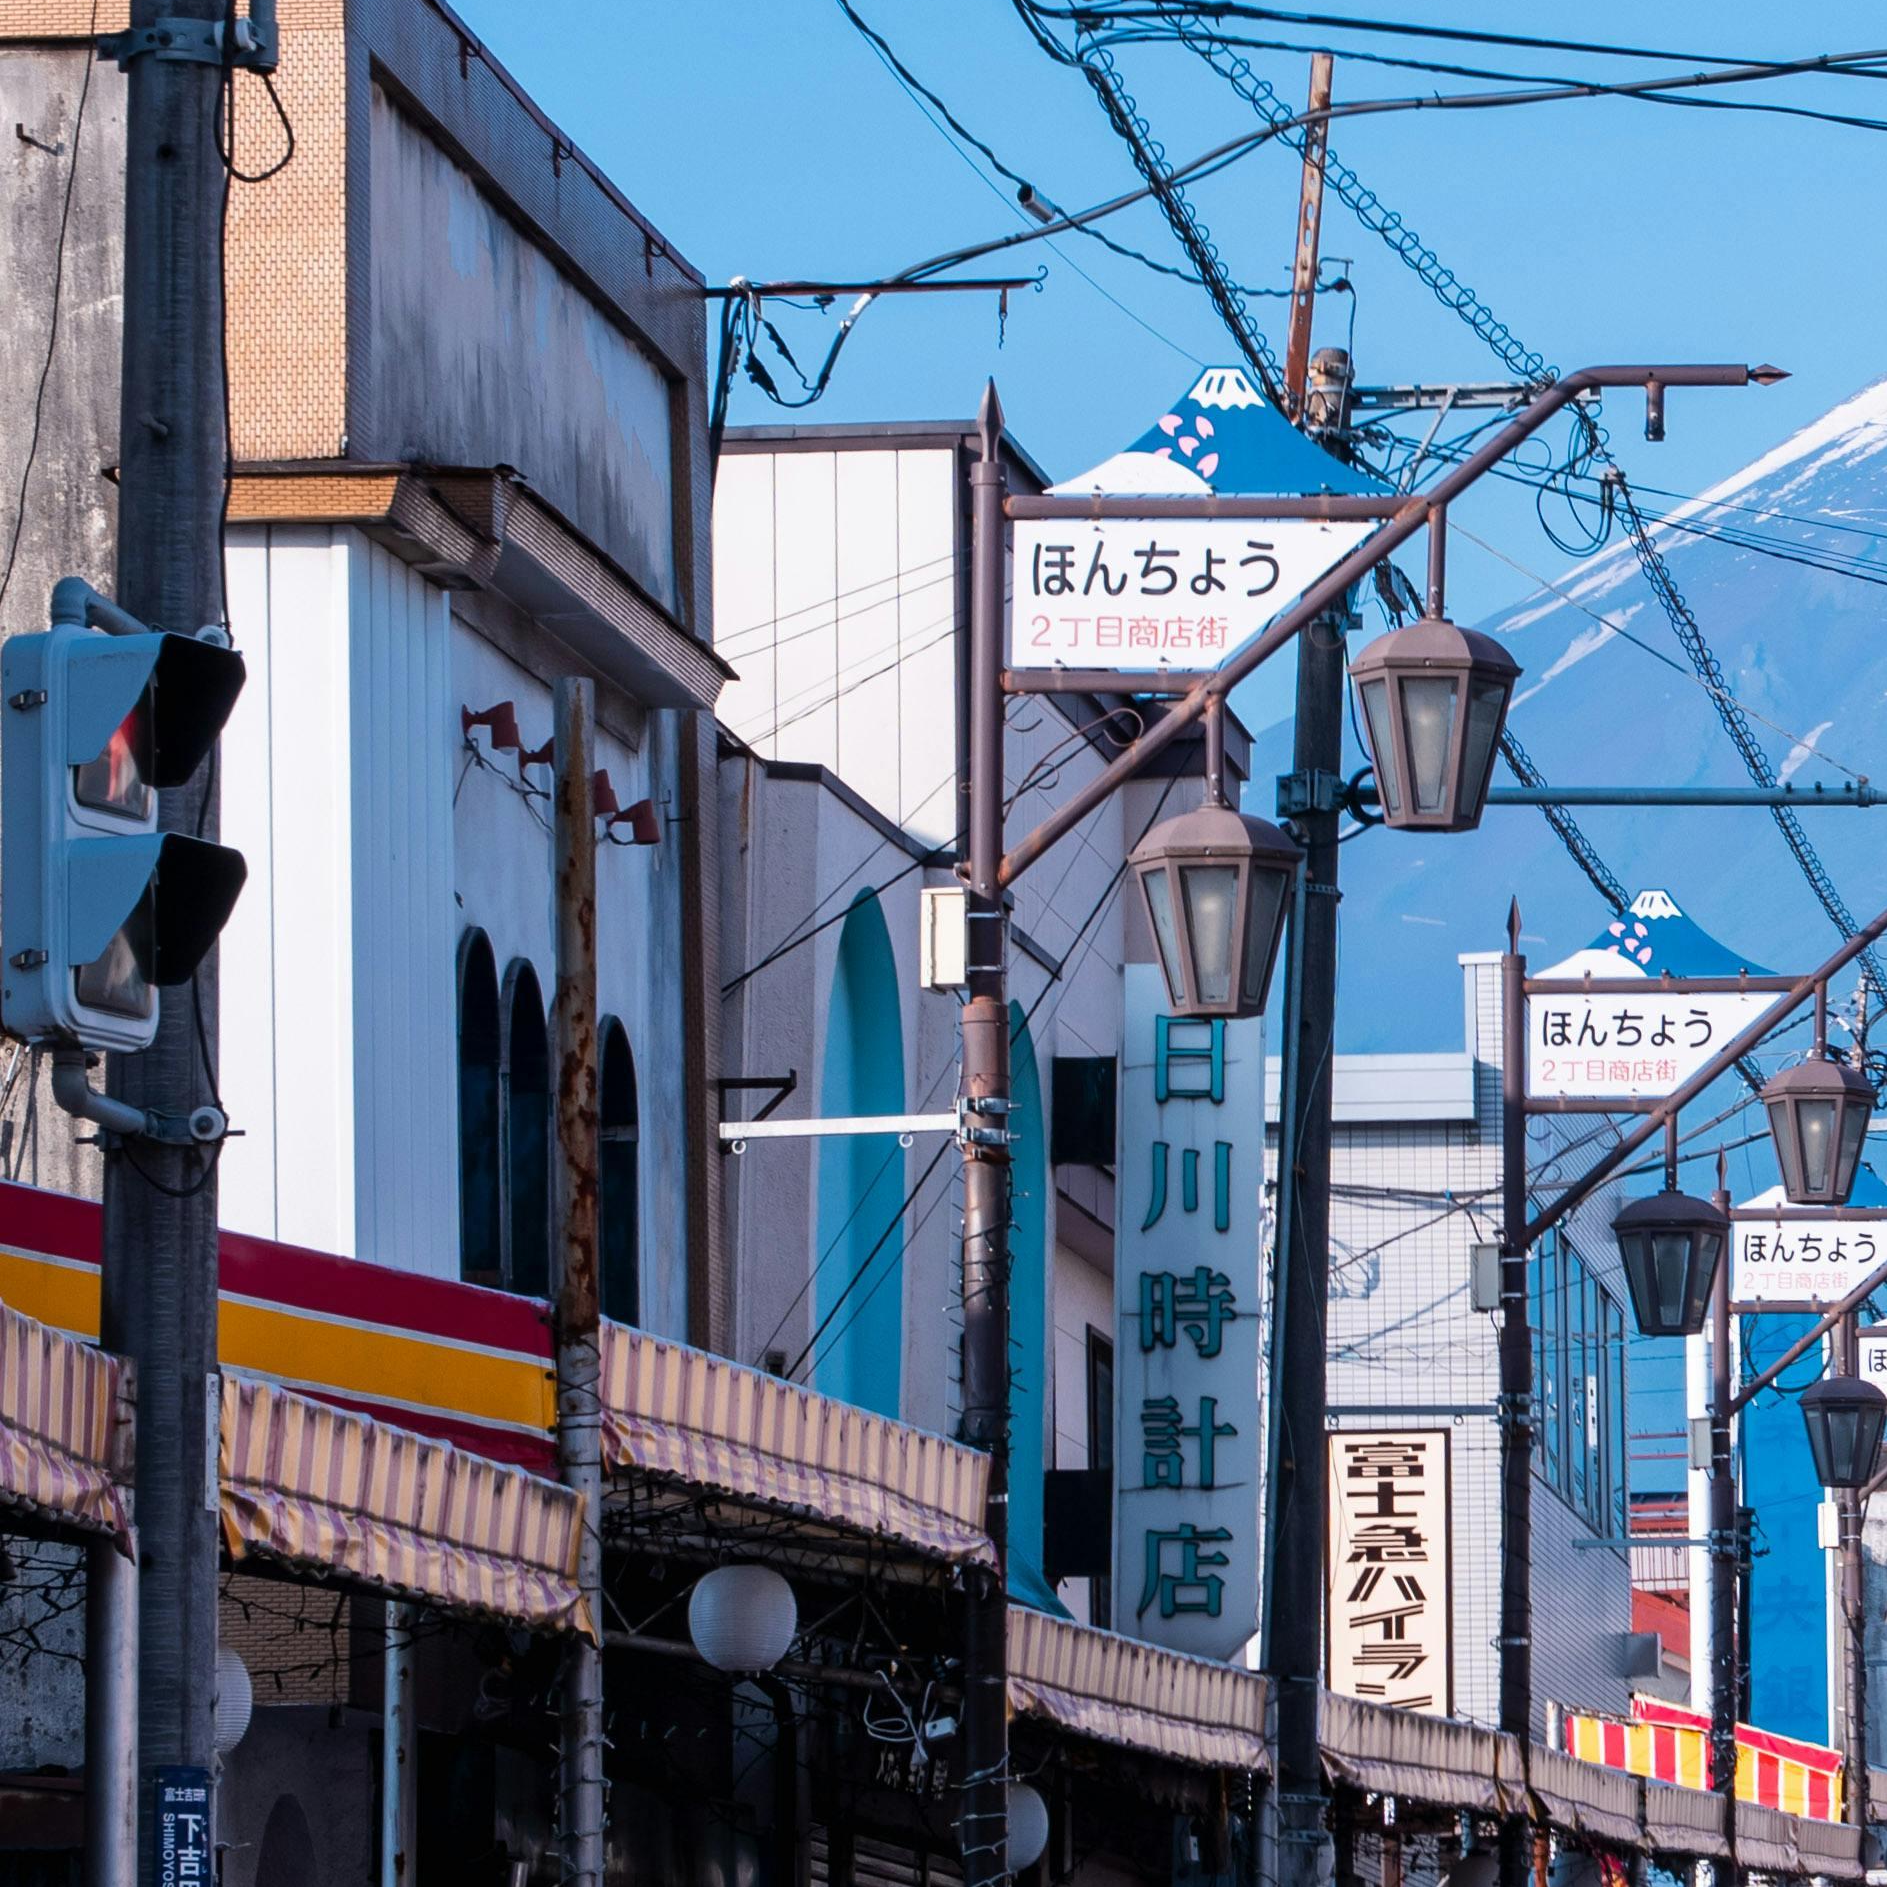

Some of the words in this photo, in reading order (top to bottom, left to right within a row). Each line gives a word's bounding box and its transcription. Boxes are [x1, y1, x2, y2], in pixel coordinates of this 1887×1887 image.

[1032, 540, 1281, 598] ほんちょう
[1541, 1008, 1714, 1049] ほんちょう
[1743, 1231, 1877, 1264] ほんちょう
